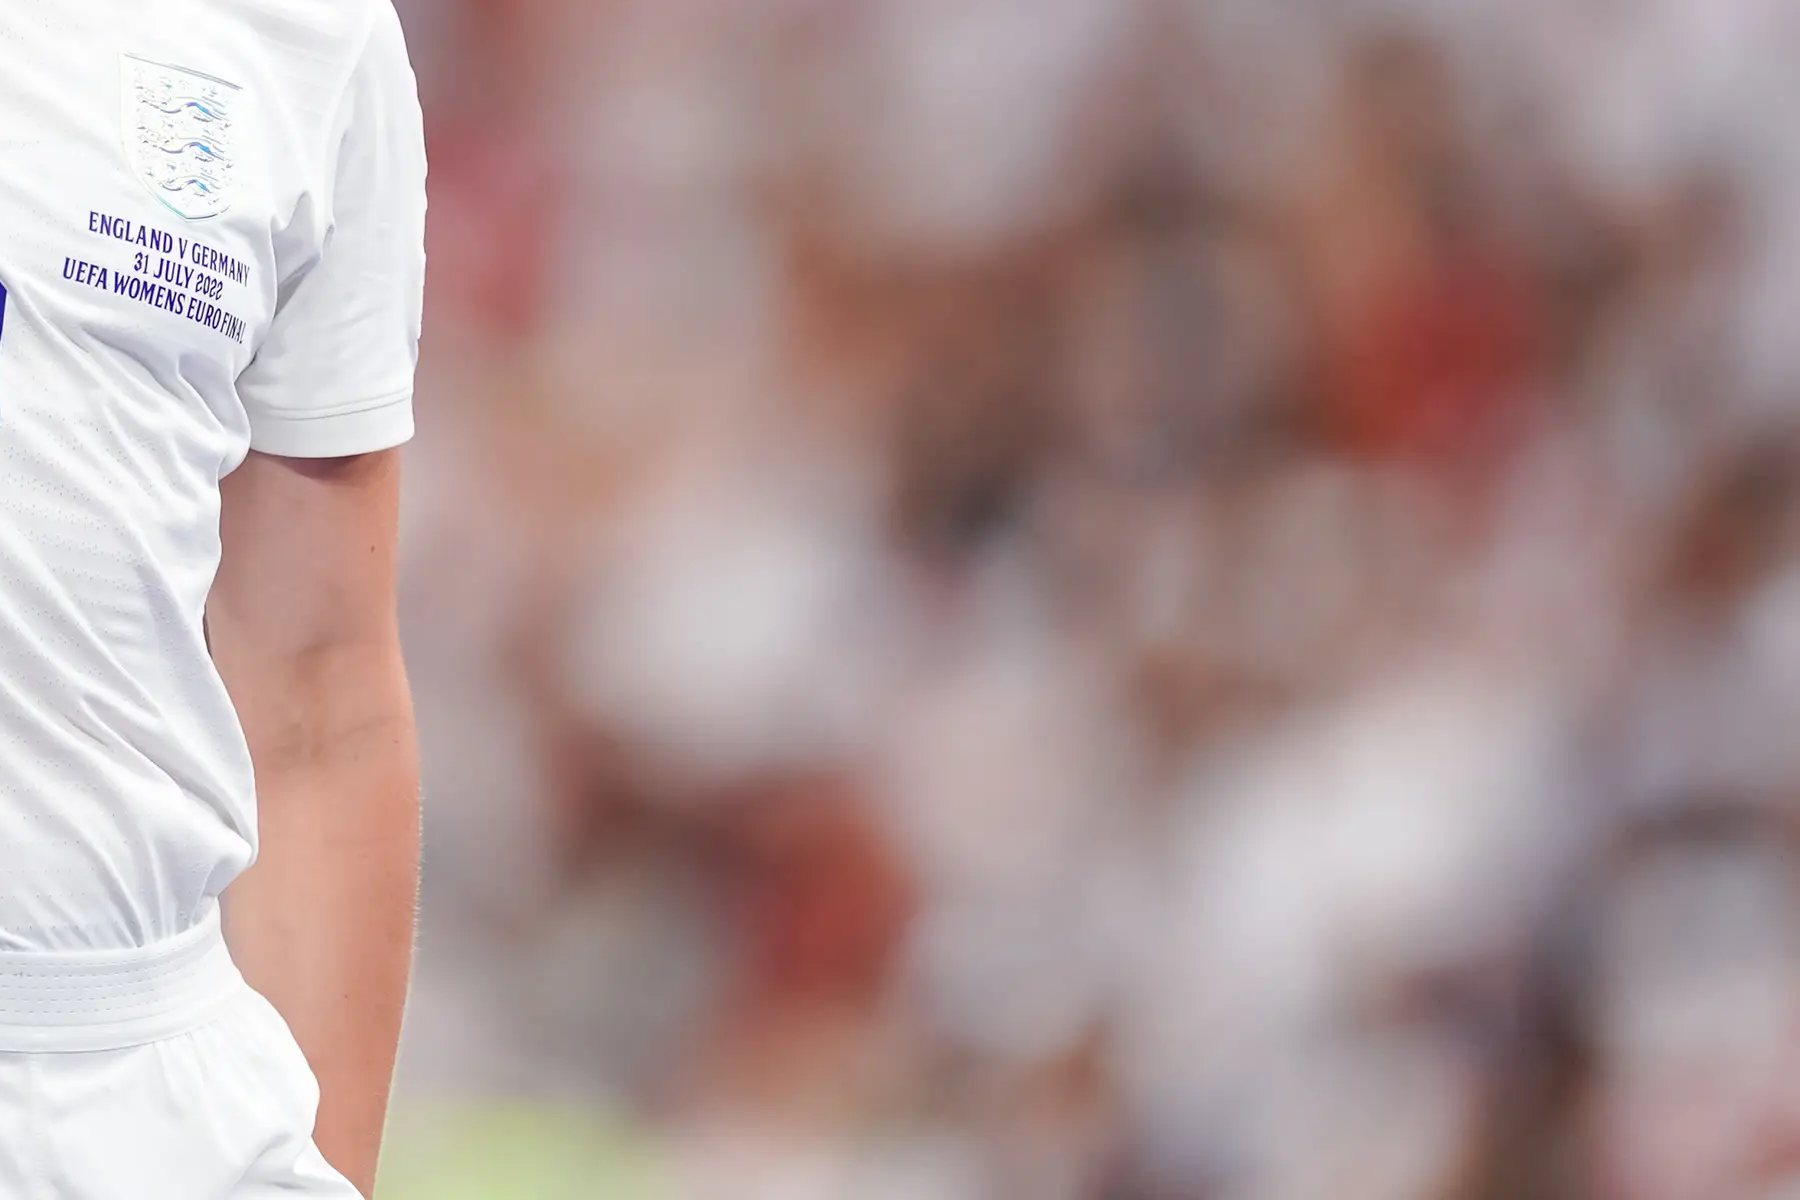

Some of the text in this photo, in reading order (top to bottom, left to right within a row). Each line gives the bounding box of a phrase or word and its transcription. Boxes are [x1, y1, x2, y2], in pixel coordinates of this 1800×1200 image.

[88, 211, 250, 287] ENGLAND V GERMANY
[134, 252, 223, 301] 31 JULY 2022
[63, 257, 108, 290] UEFA
[113, 271, 185, 315] WOMENS
[186, 297, 222, 330] EURO
